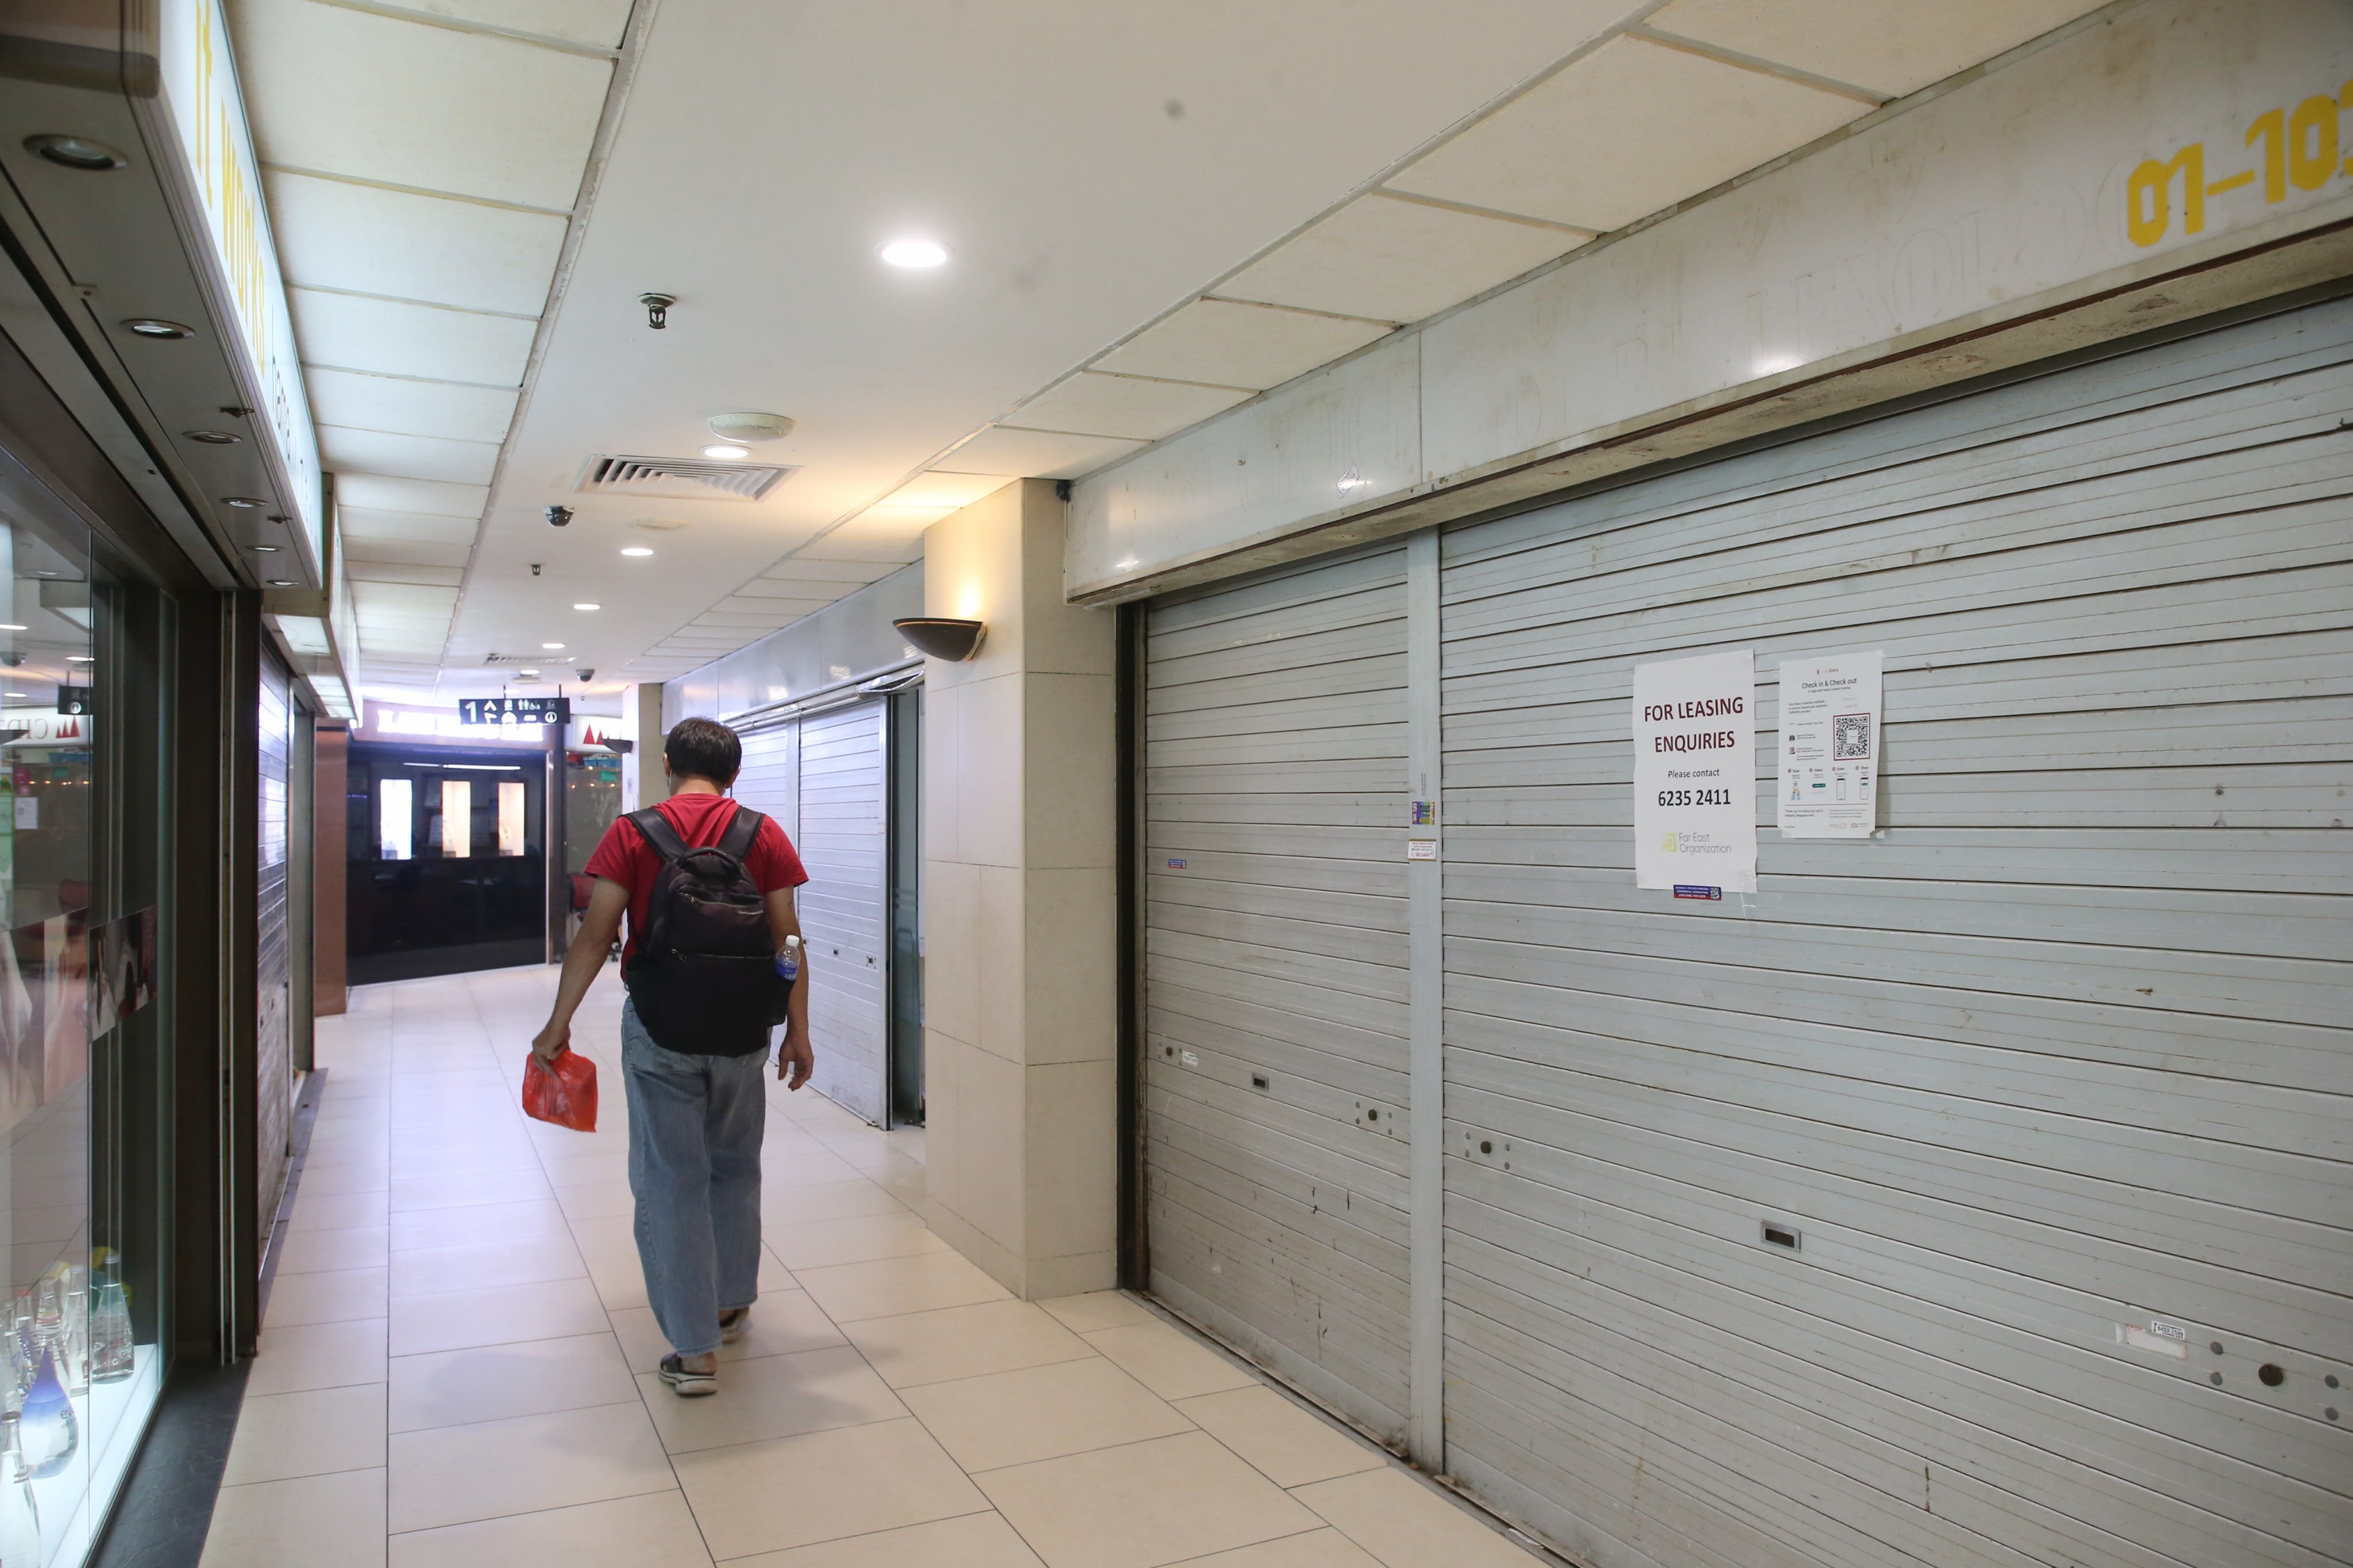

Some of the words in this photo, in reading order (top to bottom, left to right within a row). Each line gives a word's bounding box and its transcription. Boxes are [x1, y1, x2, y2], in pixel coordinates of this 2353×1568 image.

[1830, 678, 1846, 686] Check
[465, 701, 476, 723] 1
[1645, 704, 1673, 721] FOR
[1678, 697, 1743, 719] LEASING
[1655, 731, 1735, 753] ENQUIRIES
[1692, 768, 1720, 777] contact
[1658, 790, 1691, 806] 6235
[1696, 789, 1731, 805] 2411
[1679, 833, 1691, 841] Far
[1693, 833, 1710, 841] East
[1680, 843, 1731, 855] Organization
